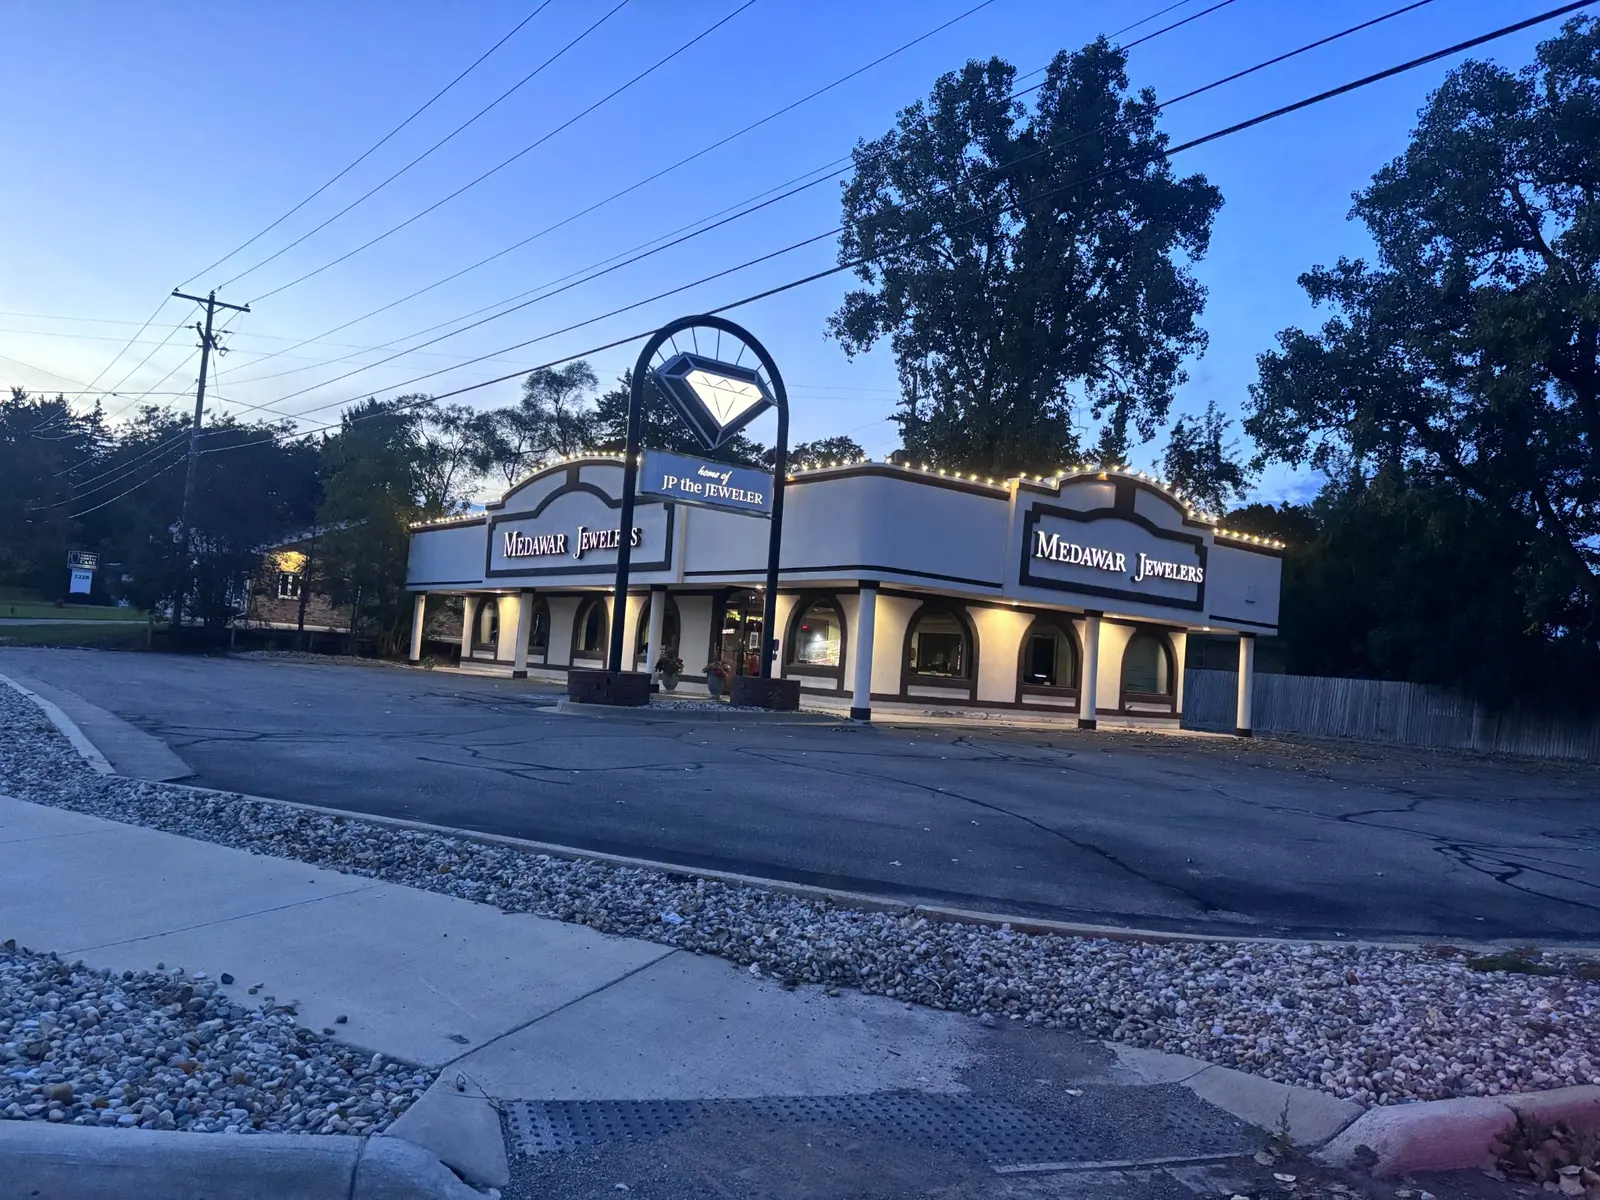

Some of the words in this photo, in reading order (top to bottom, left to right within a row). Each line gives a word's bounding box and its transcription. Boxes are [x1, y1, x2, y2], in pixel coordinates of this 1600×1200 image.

[662, 475, 677, 490] JP
[680, 478, 702, 493] the
[704, 483, 763, 504] JEWELER
[697, 465, 719, 479] home
[720, 470, 733, 486] of
[503, 530, 565, 557] MEDAWAR
[573, 526, 638, 559] JEWELES
[1036, 530, 1126, 572] MEDAWAR
[1134, 553, 1203, 583] JEWELERS
